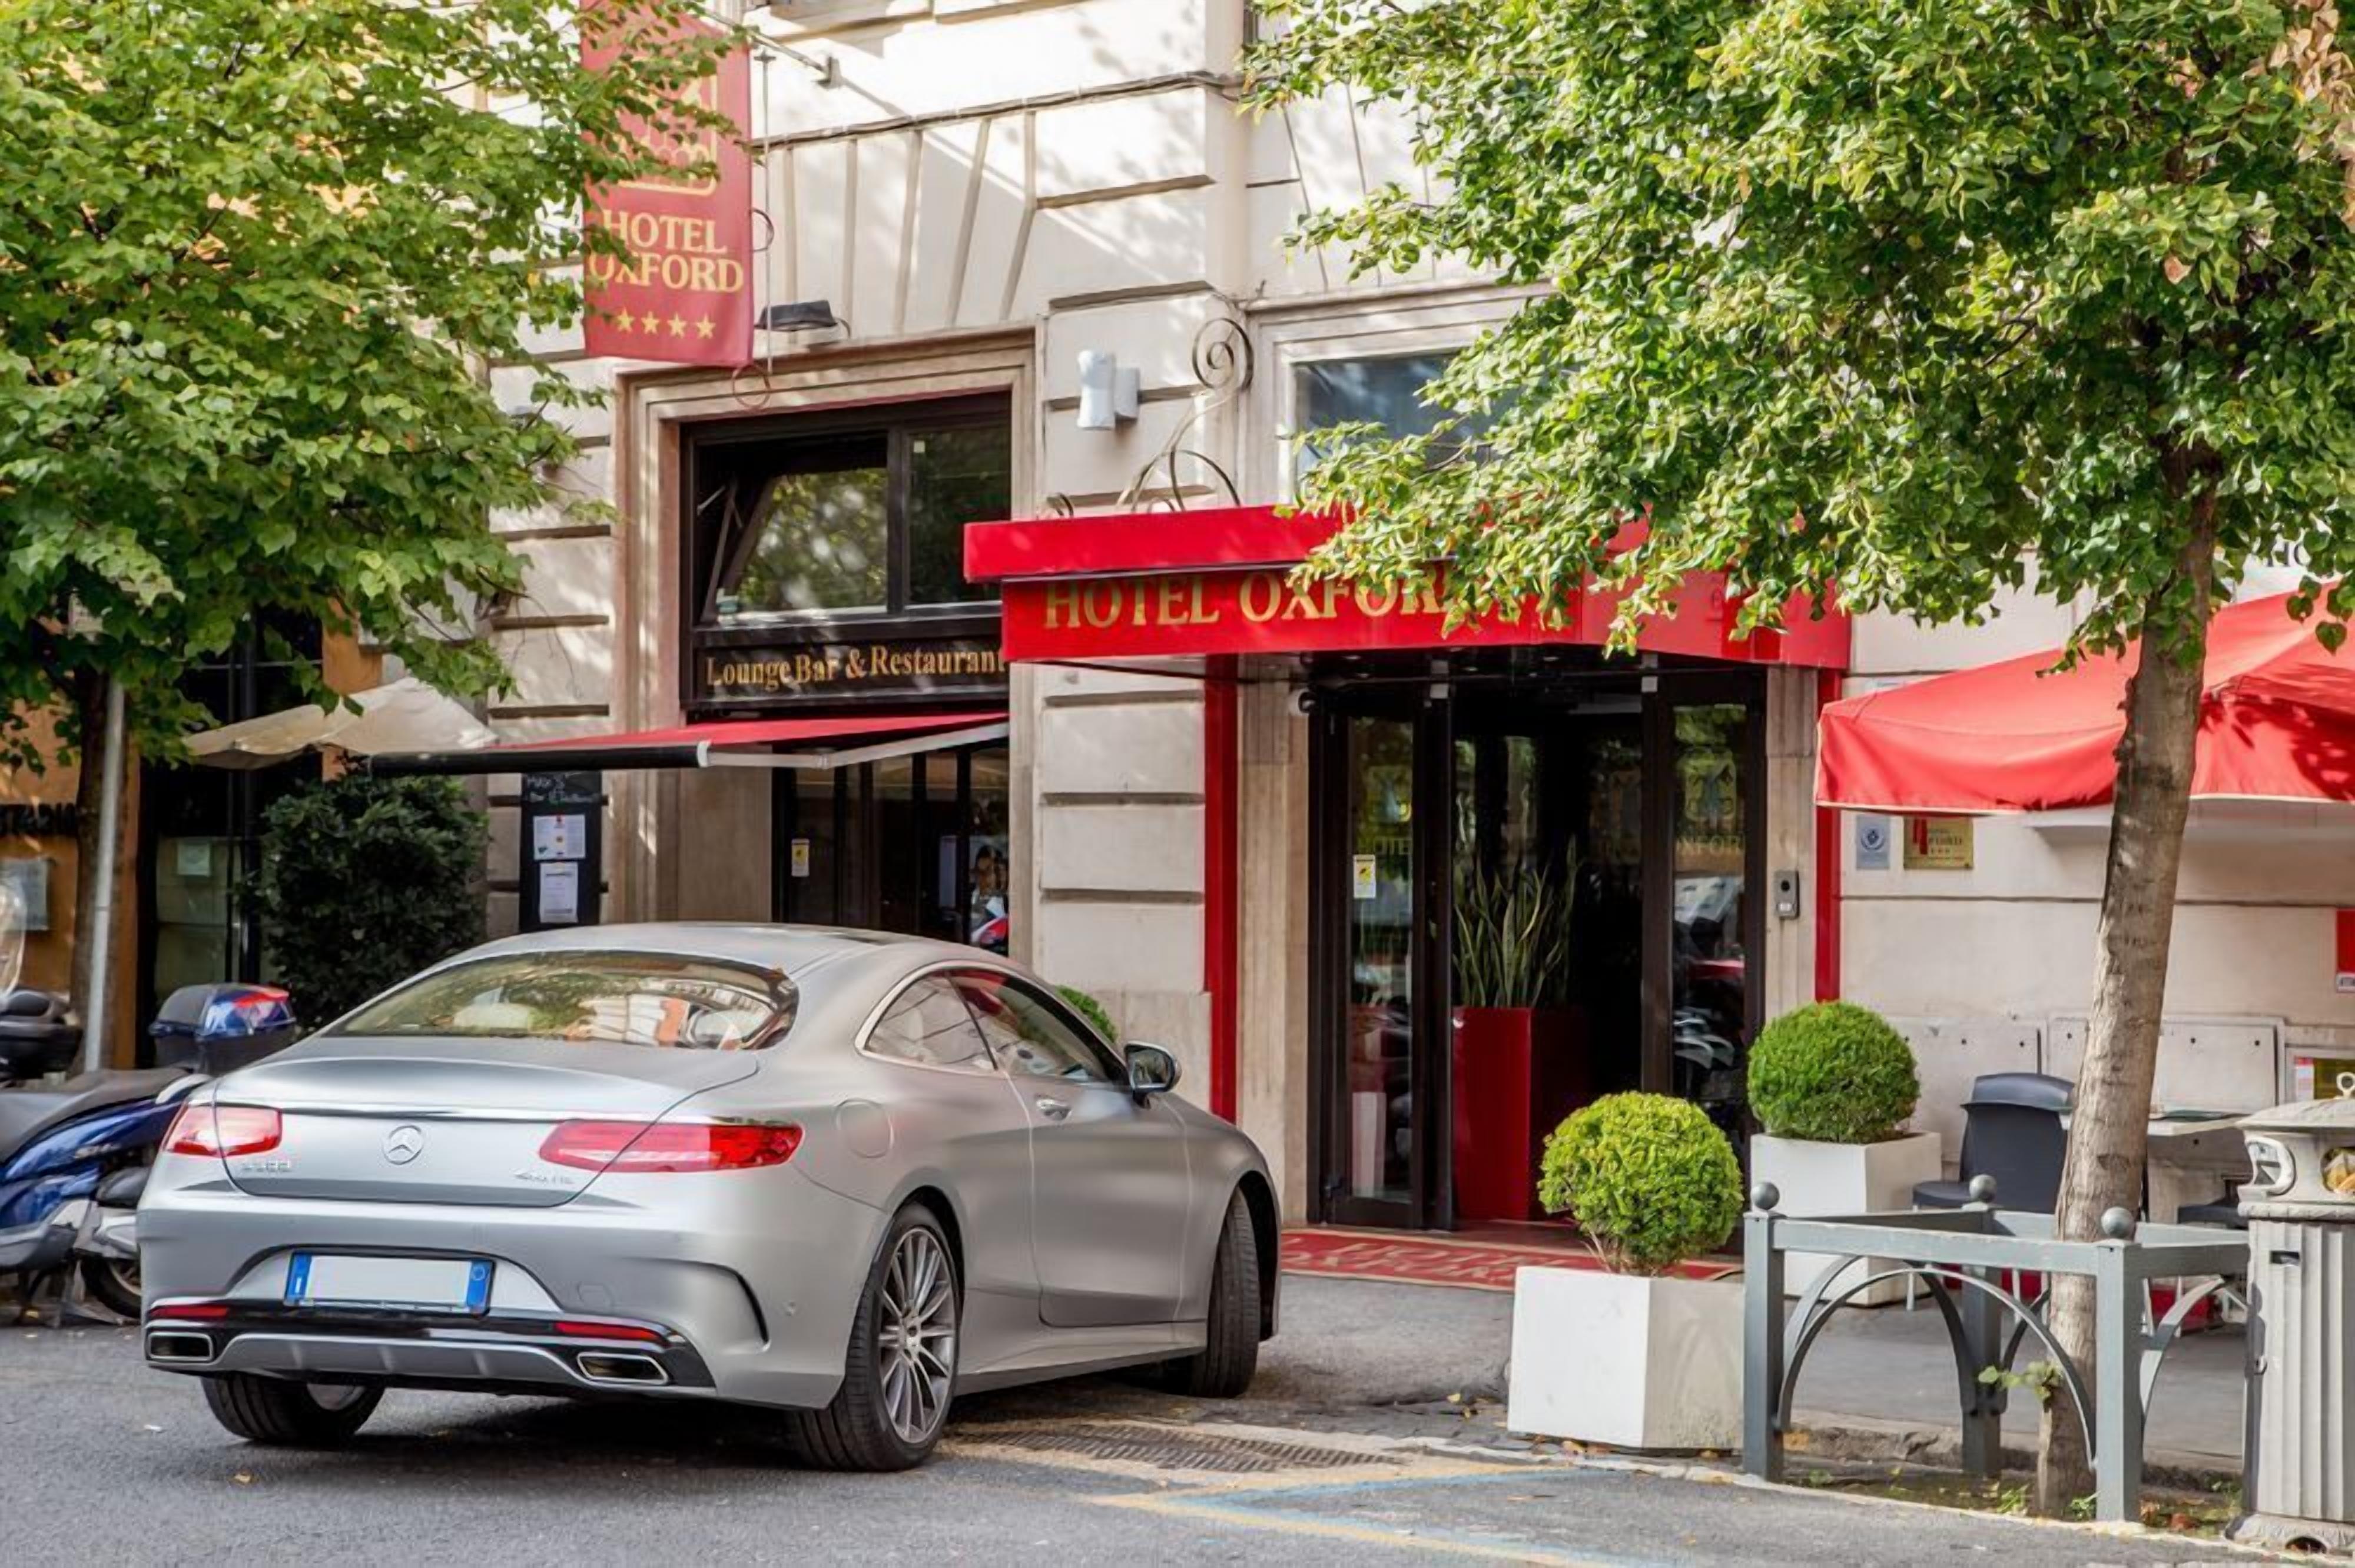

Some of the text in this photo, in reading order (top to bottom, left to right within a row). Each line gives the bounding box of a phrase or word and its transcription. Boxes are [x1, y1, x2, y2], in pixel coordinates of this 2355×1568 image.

[603, 209, 728, 254] HOTEL
[1043, 574, 1220, 629] HOTEL
[706, 656, 791, 692] Lounge
[795, 654, 839, 683] Bar
[845, 648, 867, 679] &
